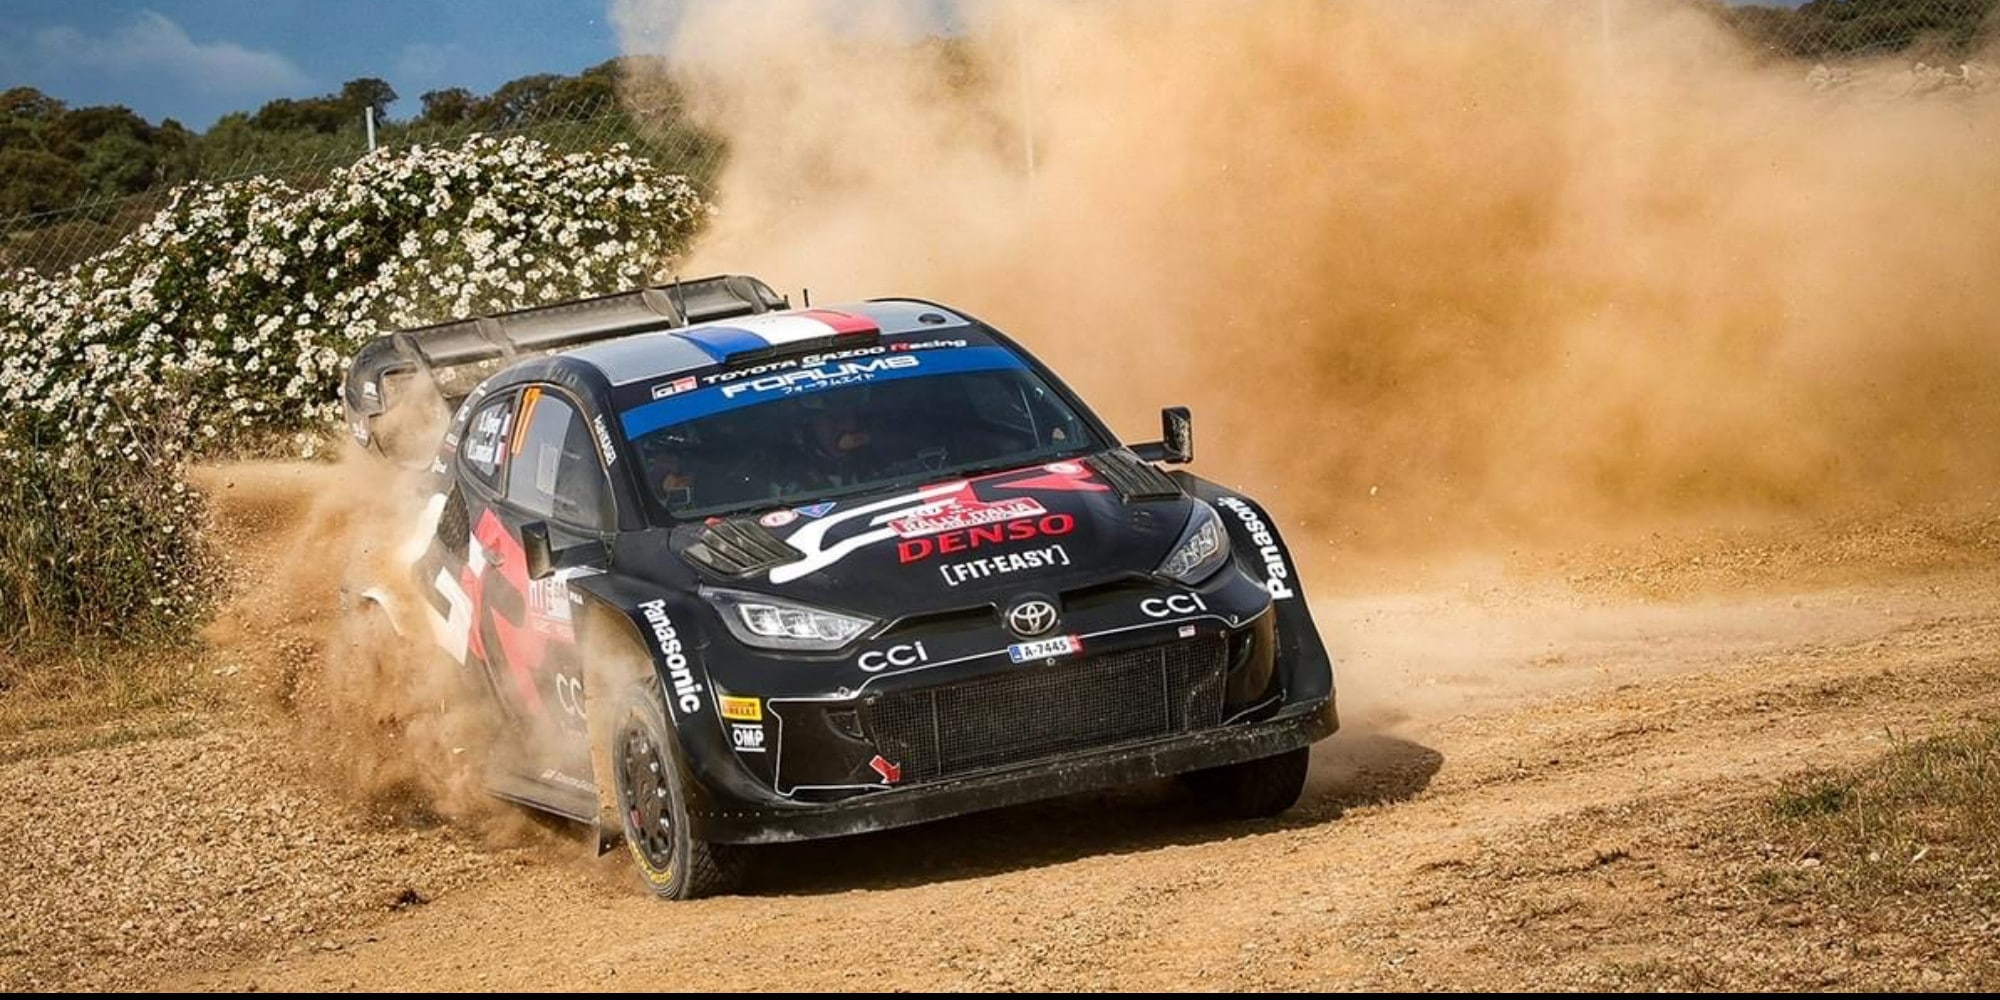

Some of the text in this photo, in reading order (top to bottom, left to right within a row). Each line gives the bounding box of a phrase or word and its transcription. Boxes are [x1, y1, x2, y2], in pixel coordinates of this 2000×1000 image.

[702, 338, 967, 384] TOYOTA GAZOO Racing
[652, 376, 698, 400] GR
[898, 513, 1075, 564] DENSO
[1218, 496, 1294, 600] Panasonic
[1139, 592, 1207, 618] CCI
[638, 599, 704, 714] Panasonic
[857, 640, 929, 673] CCI
[1024, 641, 1068, 658] A-7445
[733, 730, 765, 747] OMP
